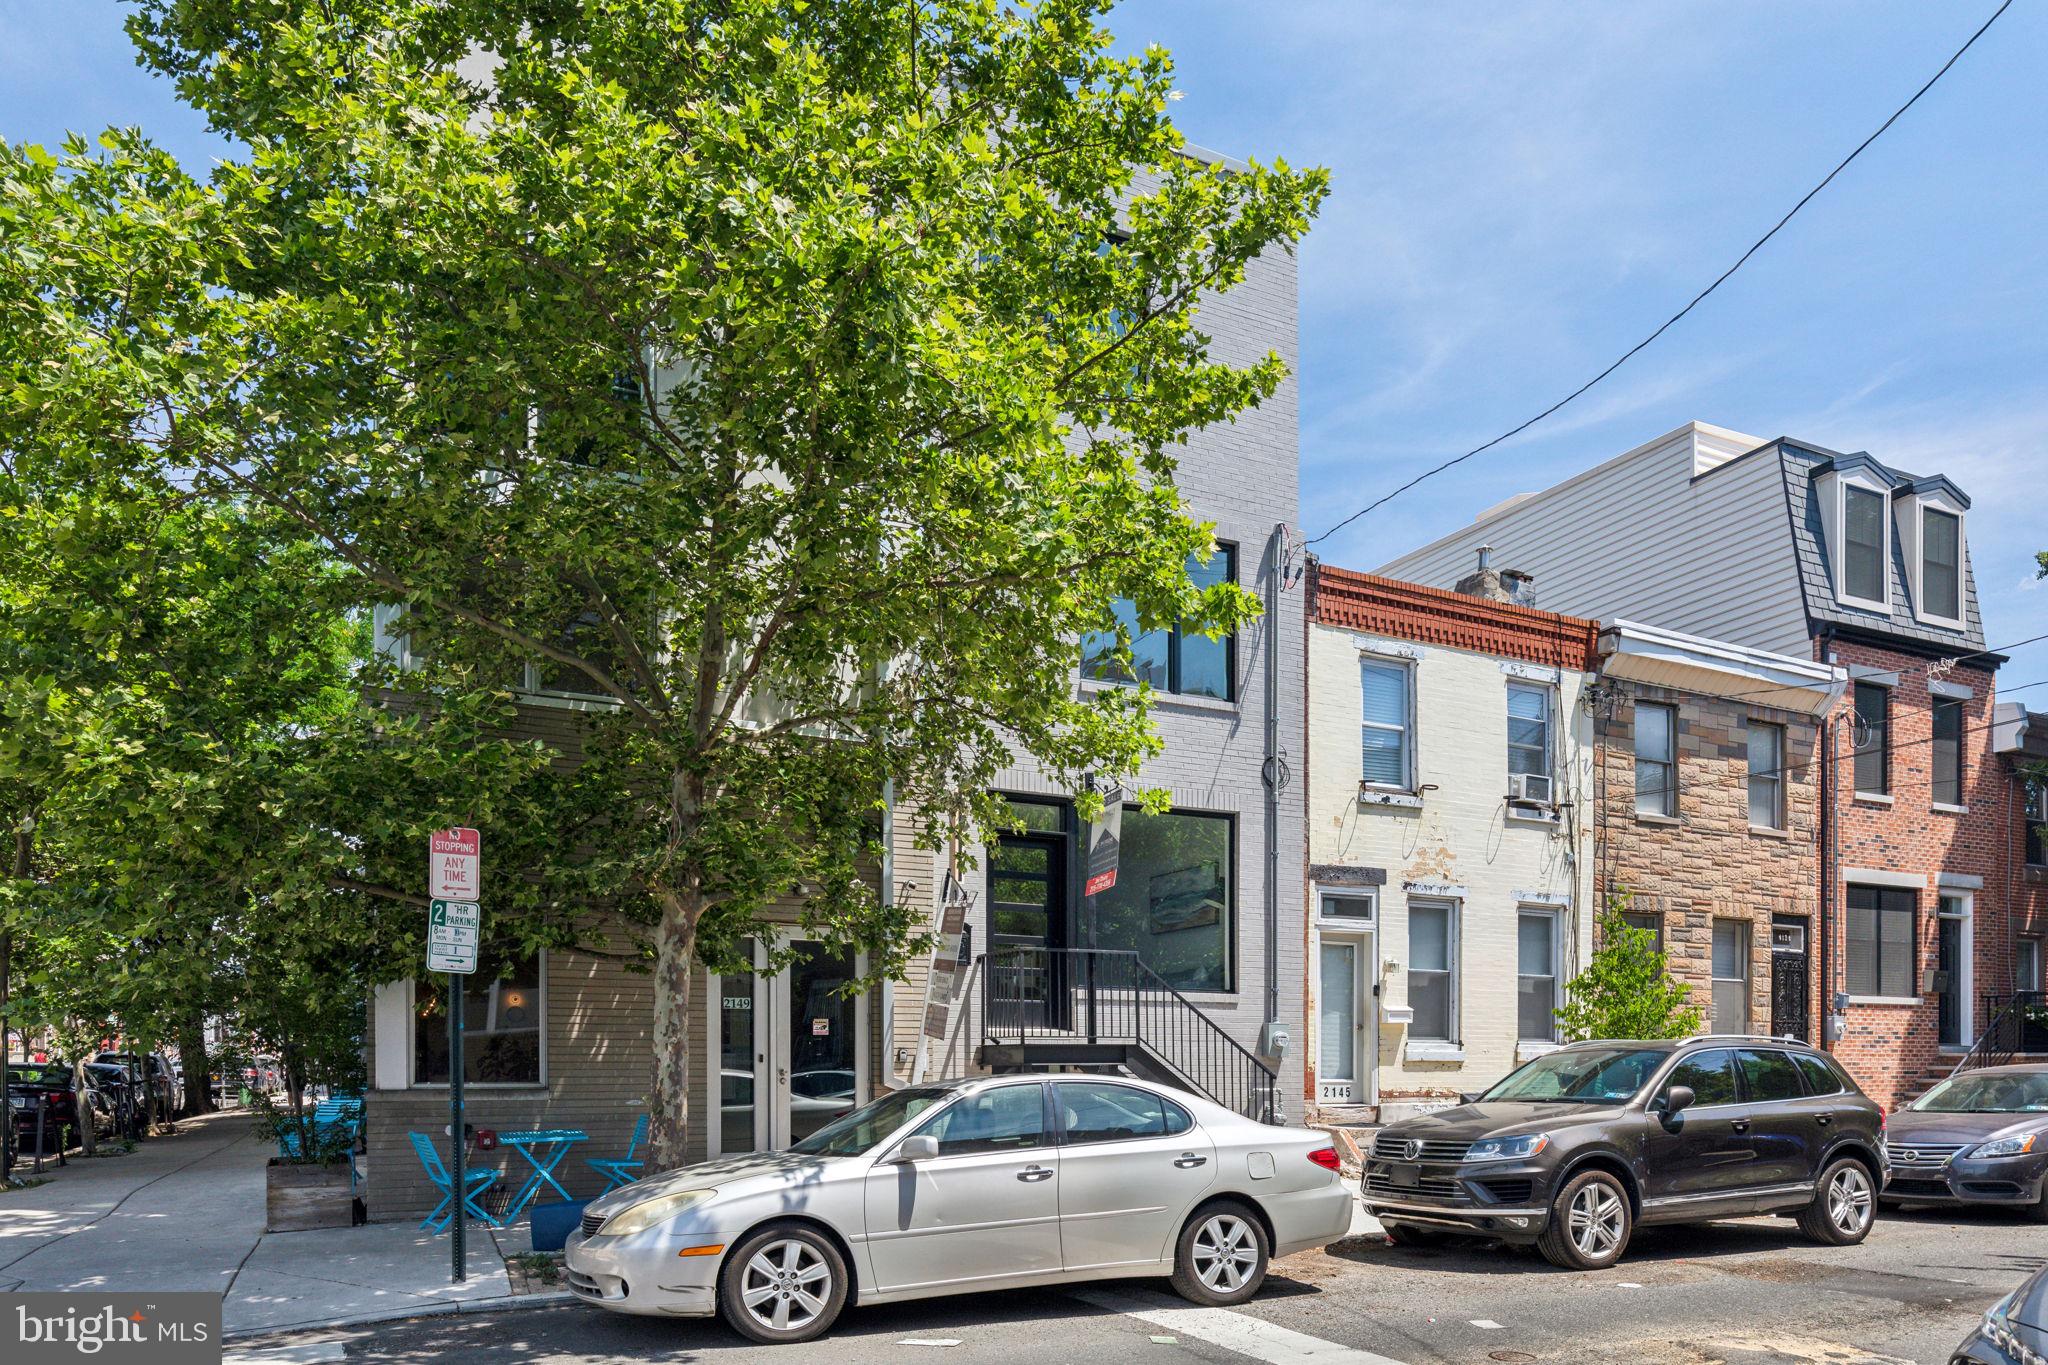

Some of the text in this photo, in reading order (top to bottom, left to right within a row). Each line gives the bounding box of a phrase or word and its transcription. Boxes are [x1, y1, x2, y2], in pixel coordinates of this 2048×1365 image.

[435, 841, 475, 853] STOPPING
[444, 857, 466, 869] ANY
[443, 870, 467, 882] TIME
[434, 904, 469, 923] 2 HR
[446, 915, 476, 927] PARKING
[724, 998, 750, 1009] 2149
[1323, 1086, 1351, 1098] 2145
